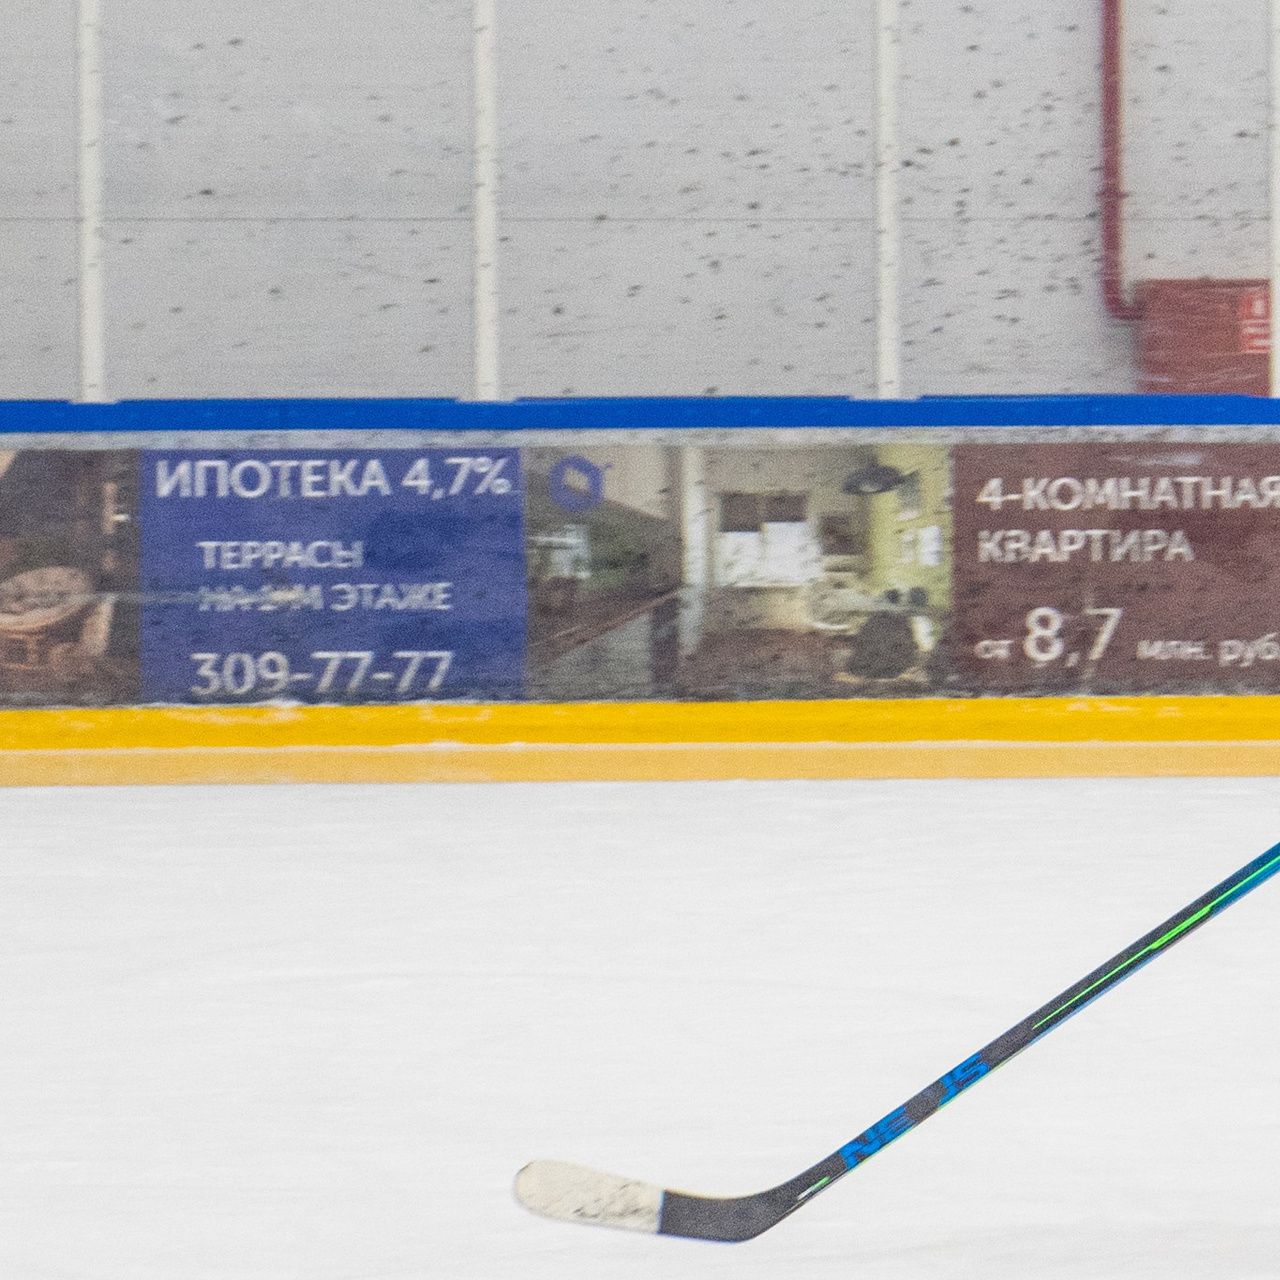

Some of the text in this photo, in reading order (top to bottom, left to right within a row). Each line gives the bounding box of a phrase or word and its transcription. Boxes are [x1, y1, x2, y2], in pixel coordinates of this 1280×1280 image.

[155, 456, 512, 501] ИПОТЕКА 4,7%
[196, 540, 364, 570] ТЕРРАСЫ
[978, 529, 1195, 564] КВАРТИРА
[330, 582, 453, 611] ЭТАЖЕ
[974, 639, 1013, 660] от
[1023, 606, 1125, 669] 8,7
[190, 651, 454, 696] 309-77-77
